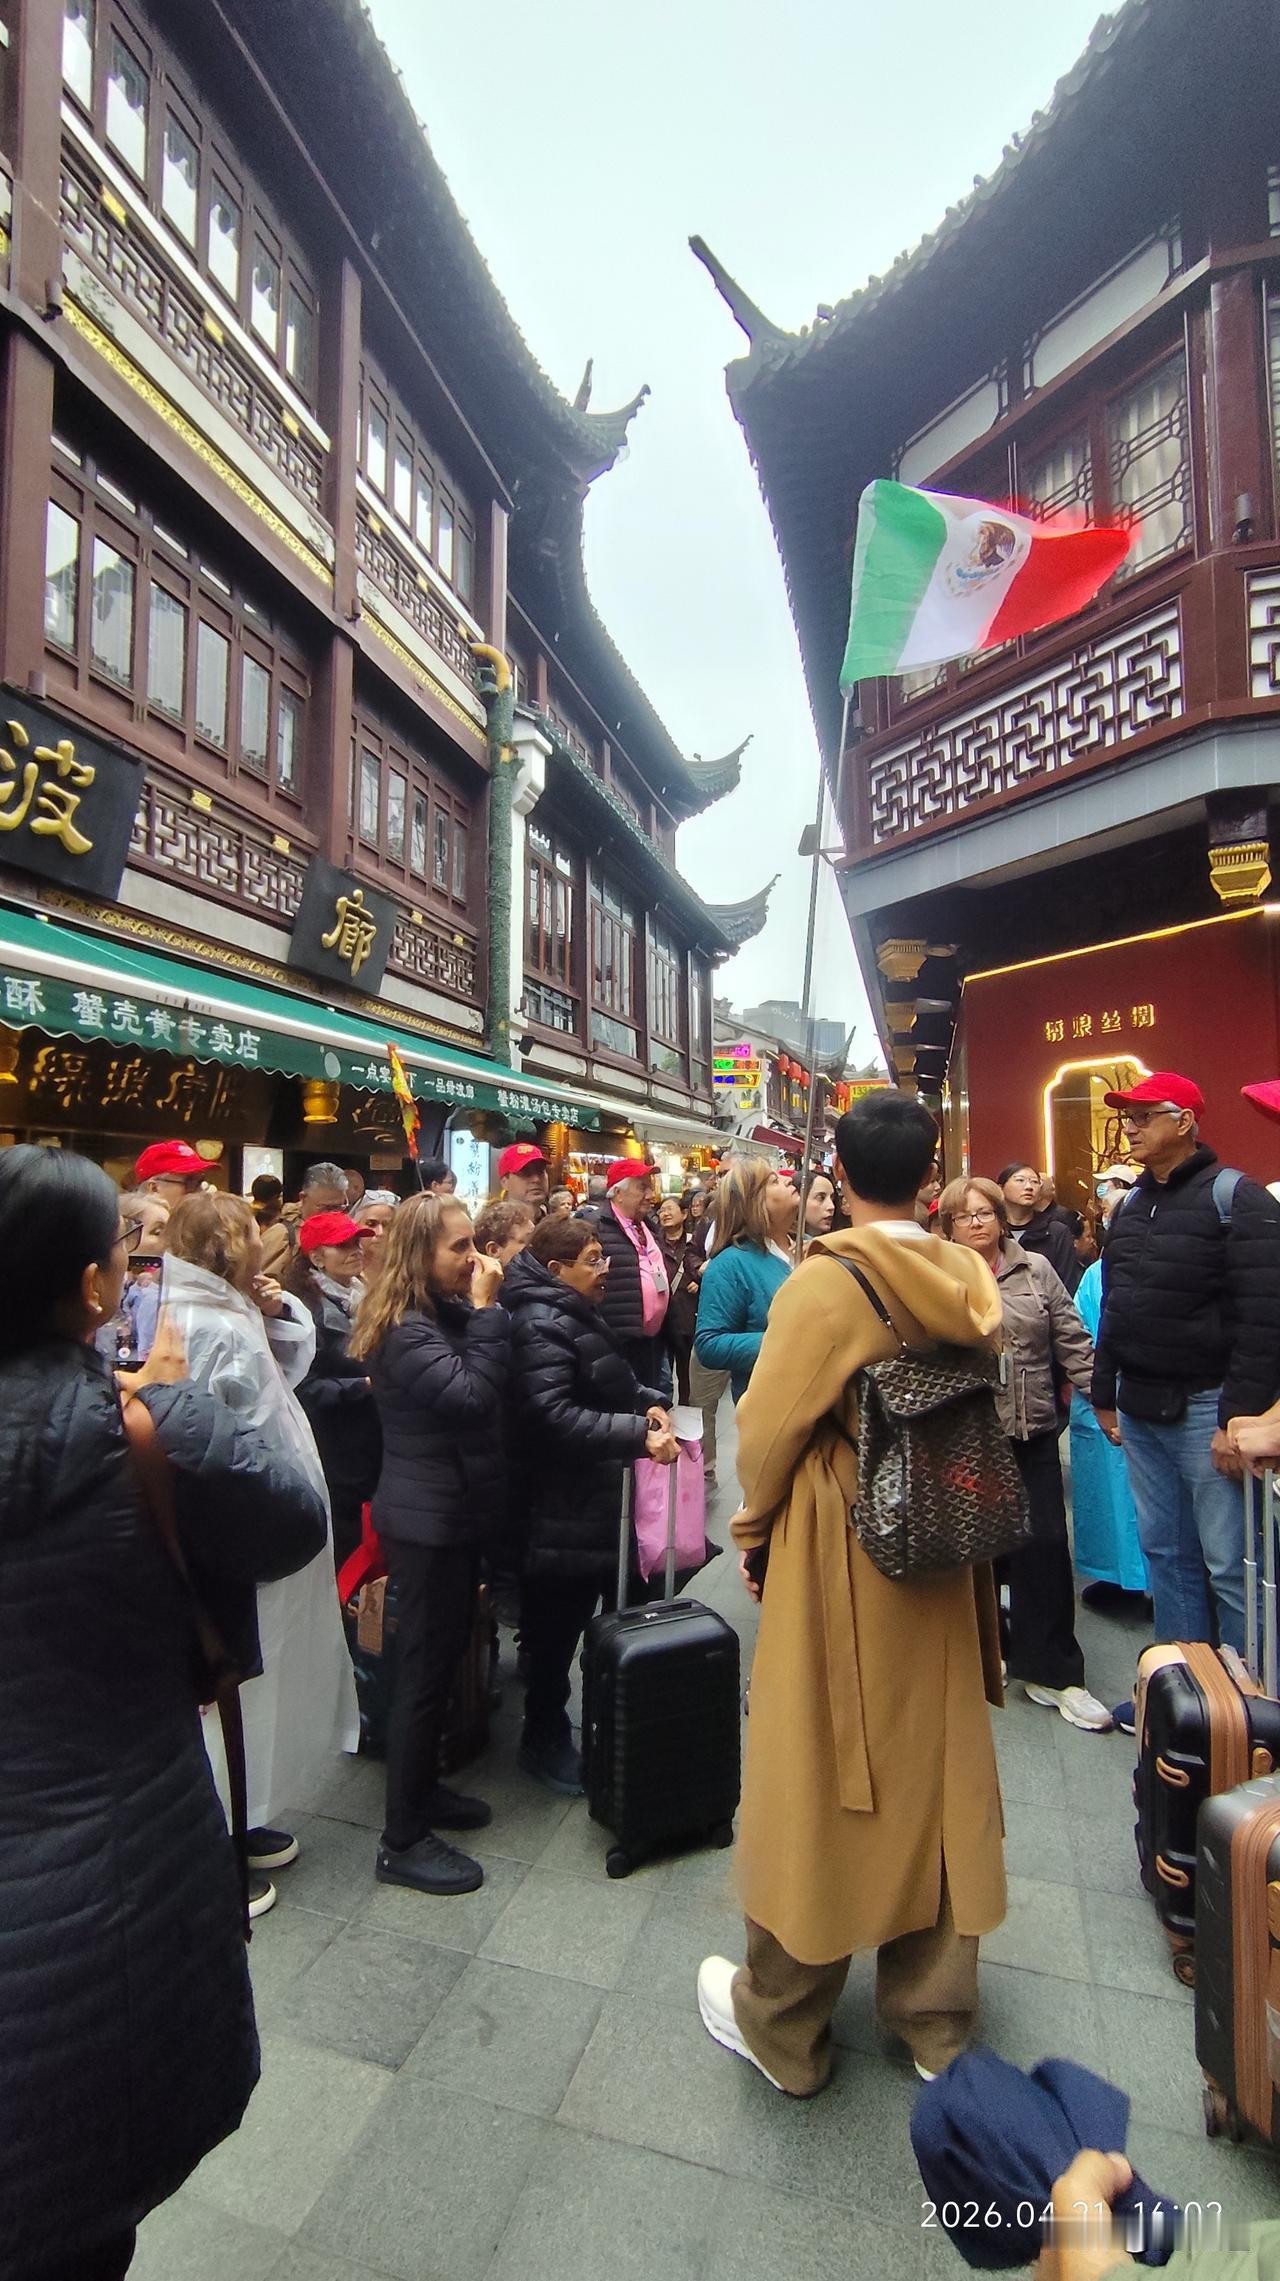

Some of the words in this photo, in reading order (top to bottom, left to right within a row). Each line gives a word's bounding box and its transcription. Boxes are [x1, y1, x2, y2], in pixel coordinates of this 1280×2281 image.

[0, 719, 96, 855] 波
[321, 888, 377, 977] 廊
[3, 976, 46, 1016] 酥
[72, 991, 262, 1061] 蟹壳黄专卖店
[351, 1062, 418, 1089] 一点宴下
[497, 1089, 579, 1123] 蟹粉灌汤包专卖店
